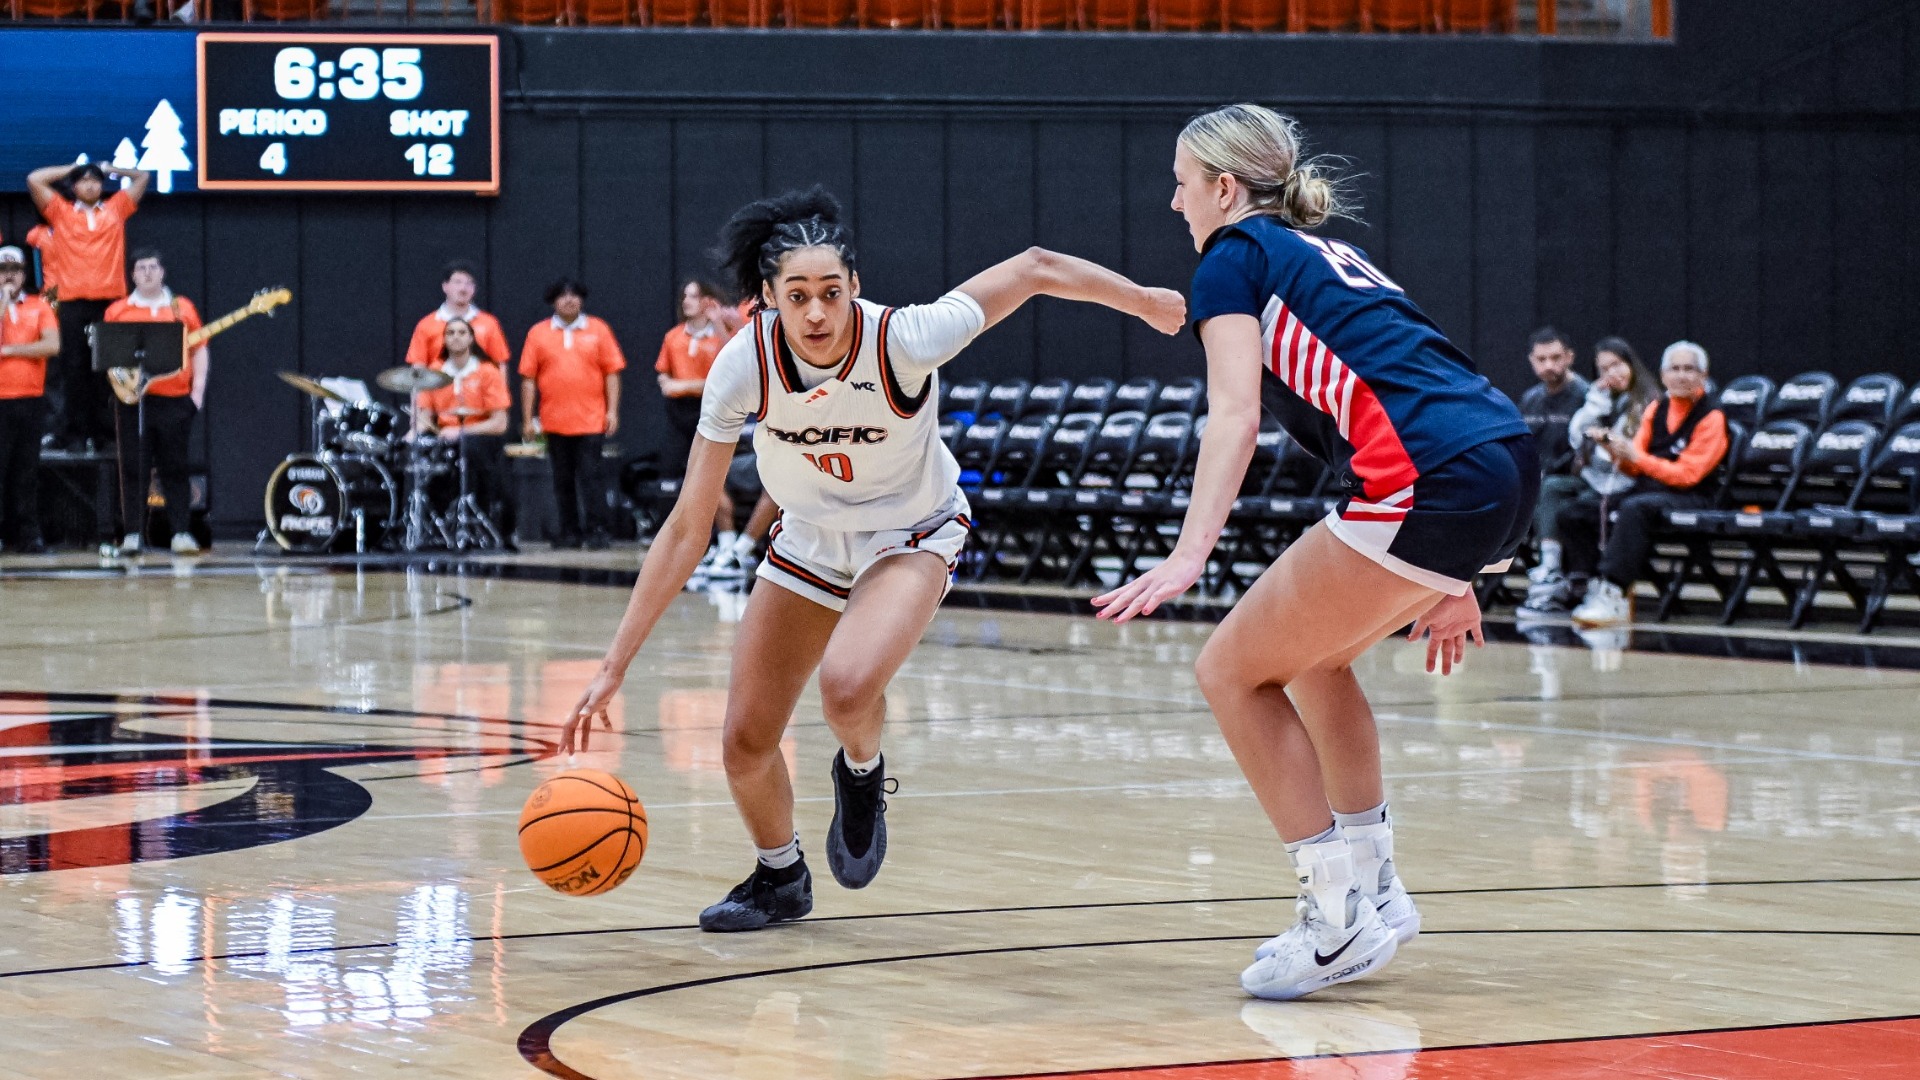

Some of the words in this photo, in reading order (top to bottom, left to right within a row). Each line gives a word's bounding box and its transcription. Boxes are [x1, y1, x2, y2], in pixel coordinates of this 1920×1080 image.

[274, 47, 423, 100] 6:35
[219, 108, 327, 136] PERIOD
[389, 109, 469, 137] SHOT
[259, 142, 288, 175] 4
[404, 143, 454, 176] 12
